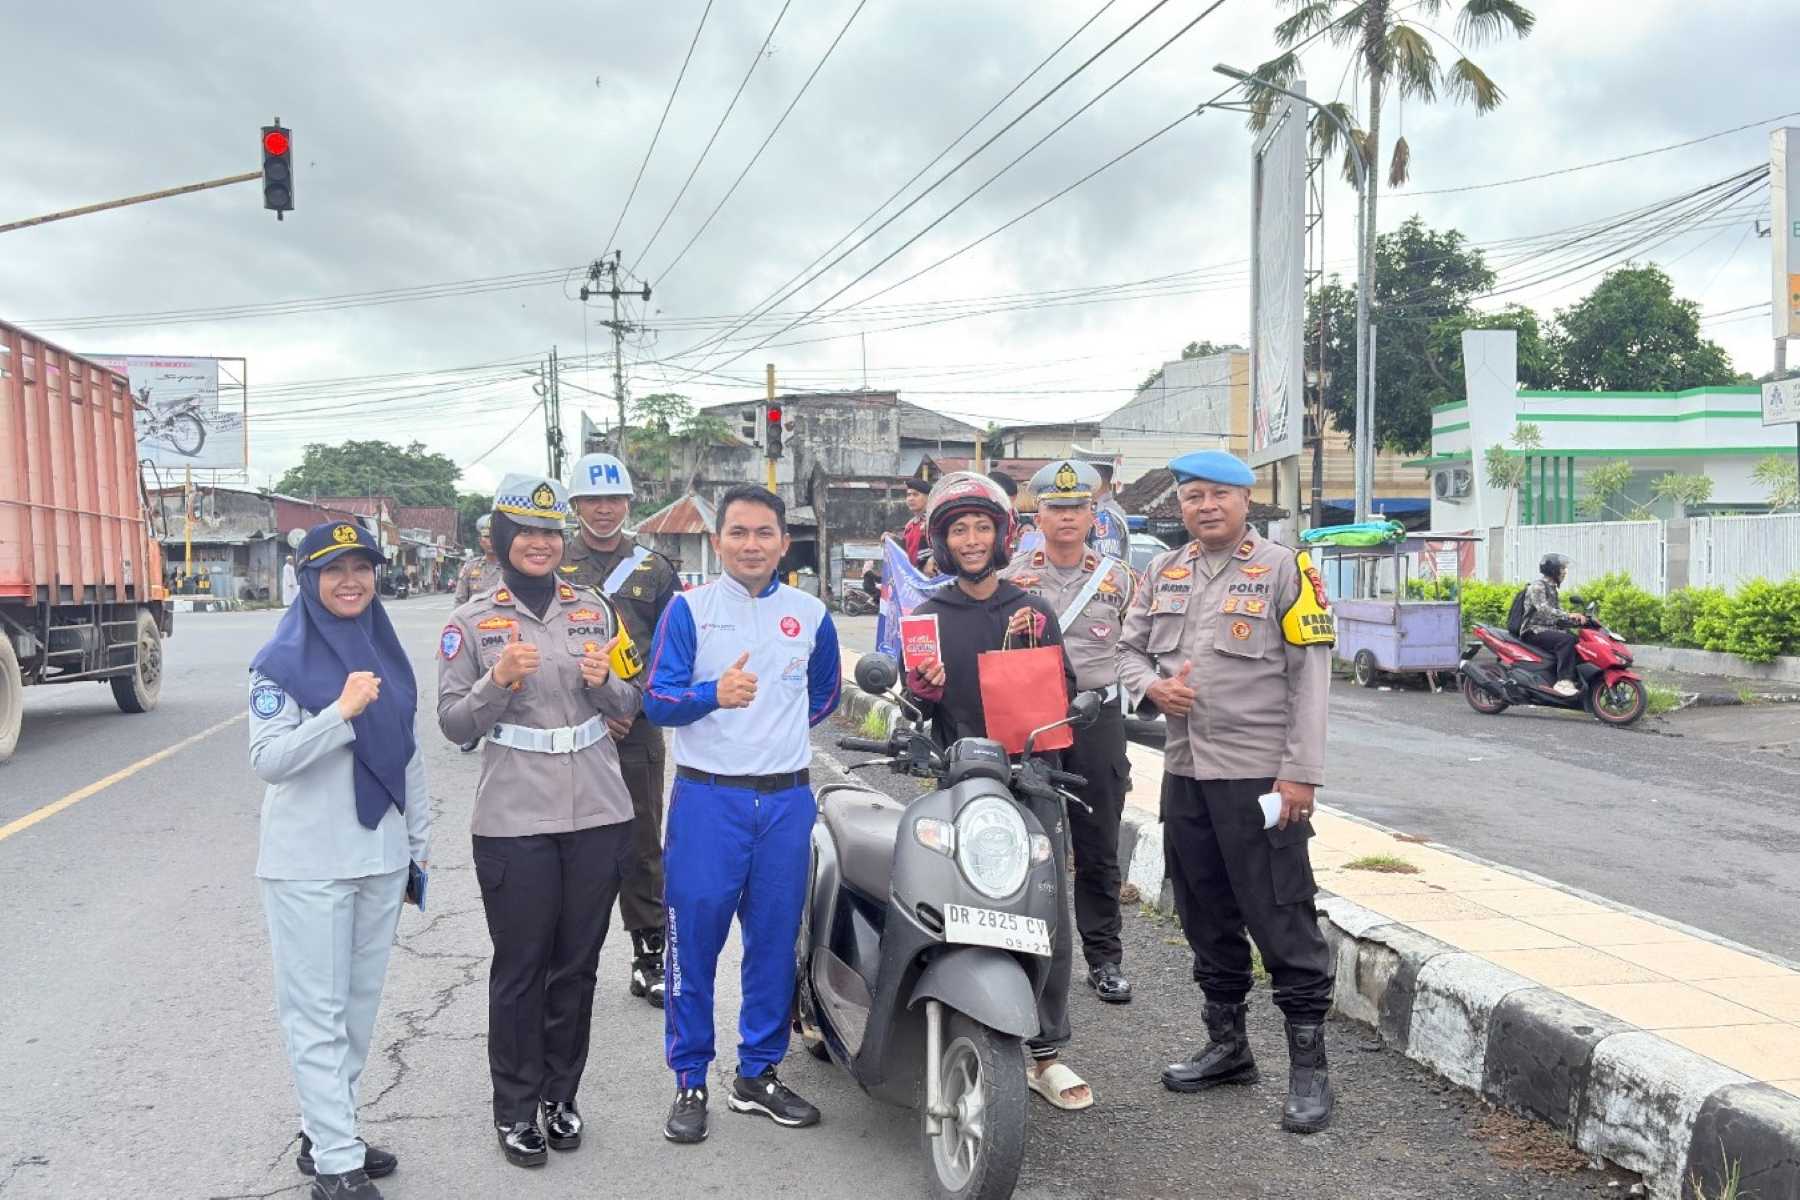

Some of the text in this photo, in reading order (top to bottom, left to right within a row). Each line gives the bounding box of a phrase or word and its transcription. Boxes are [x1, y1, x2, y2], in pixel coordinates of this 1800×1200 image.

[589, 464, 620, 485] PM
[1228, 583, 1270, 594] POLRI
[568, 626, 605, 636] POLRI
[950, 905, 970, 925] DR
